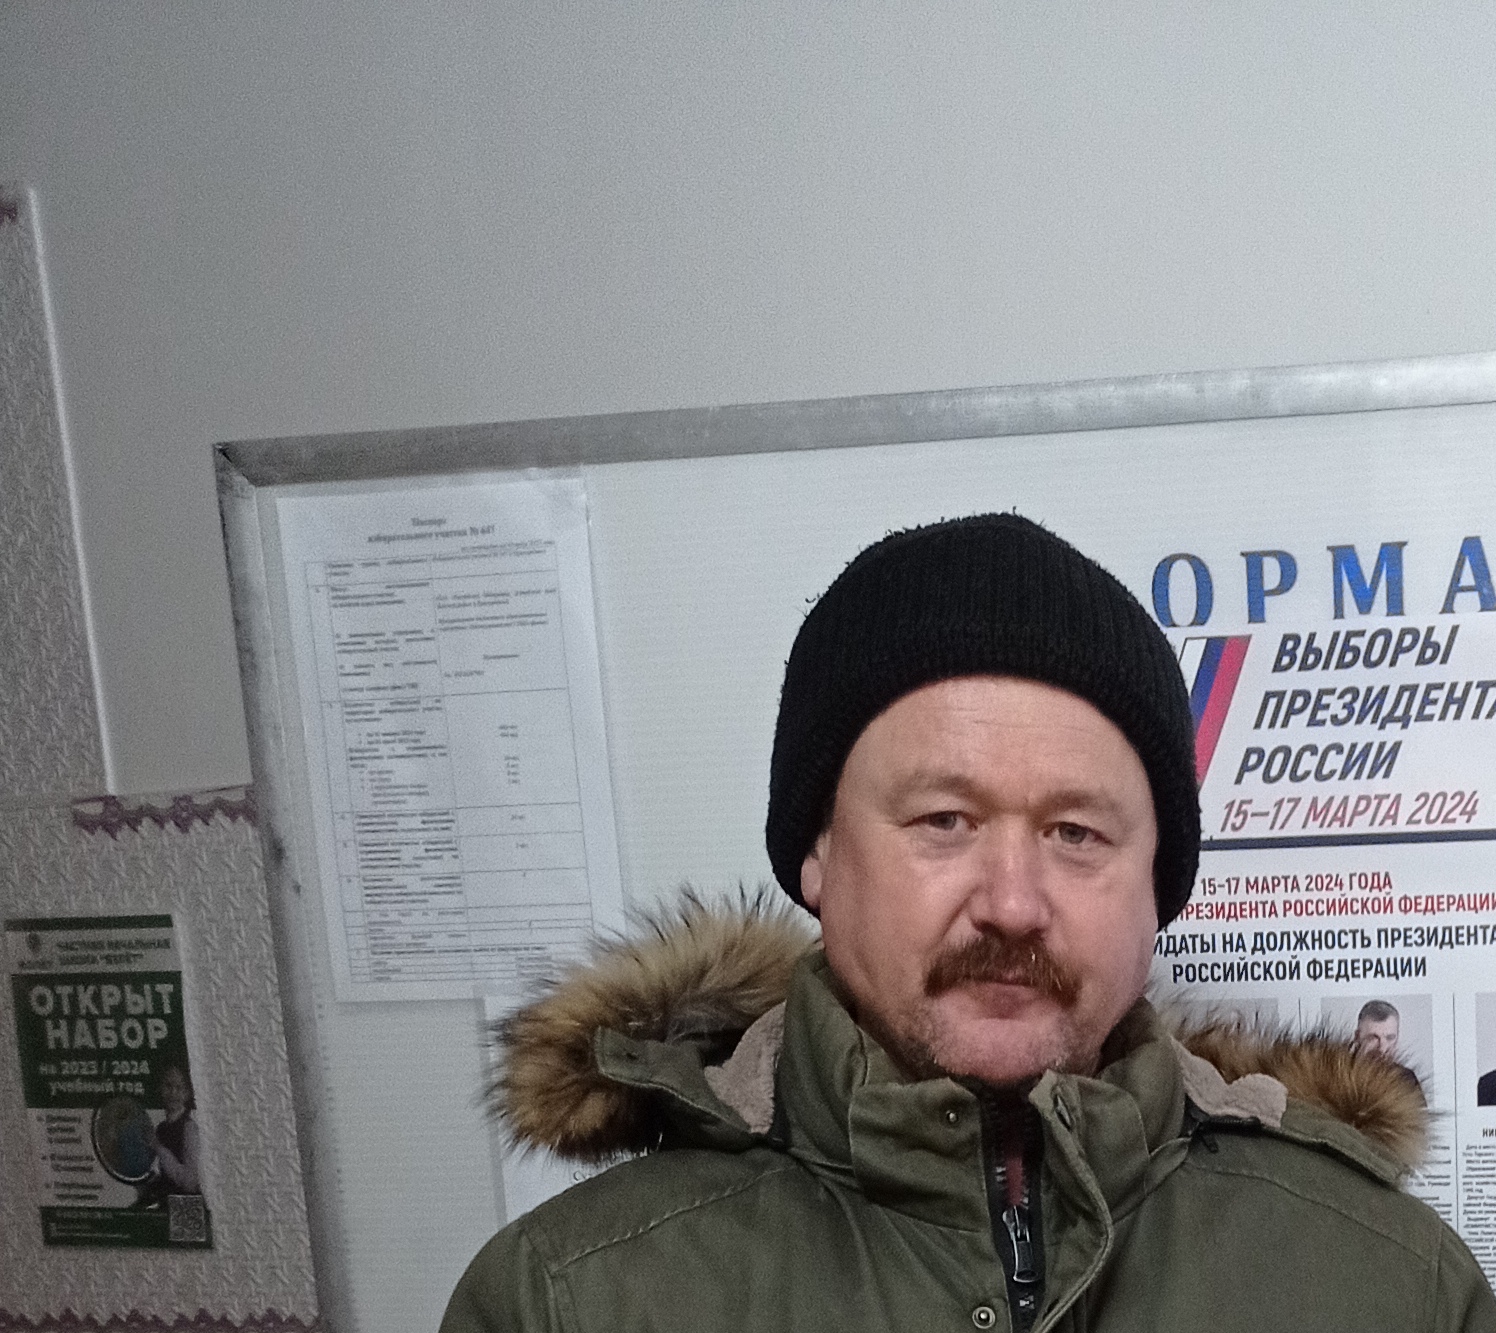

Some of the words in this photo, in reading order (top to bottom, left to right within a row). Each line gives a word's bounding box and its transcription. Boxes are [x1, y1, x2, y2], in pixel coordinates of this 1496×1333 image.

[1272, 624, 1461, 675] ВЫБОРЫ
[1234, 739, 1402, 787] РОССИИ
[1302, 793, 1399, 831] МАРТА
[1404, 790, 1480, 827] 2024
[1245, 874, 1301, 895] МАРТА
[1304, 872, 1344, 893] 2024
[1348, 871, 1393, 892] ГОДА
[1282, 892, 1394, 918] РОССИЙСКОЙ
[1221, 931, 1247, 954] НА
[1251, 928, 1372, 955] ДОЛЖНОСТЬ
[1172, 955, 1301, 984] РОССИЙСКОЙ
[1306, 956, 1427, 983] ФЕДЕРАЦИИ
[28, 983, 174, 1016] ОТКРЫТ
[45, 1017, 169, 1050] НАБОР
